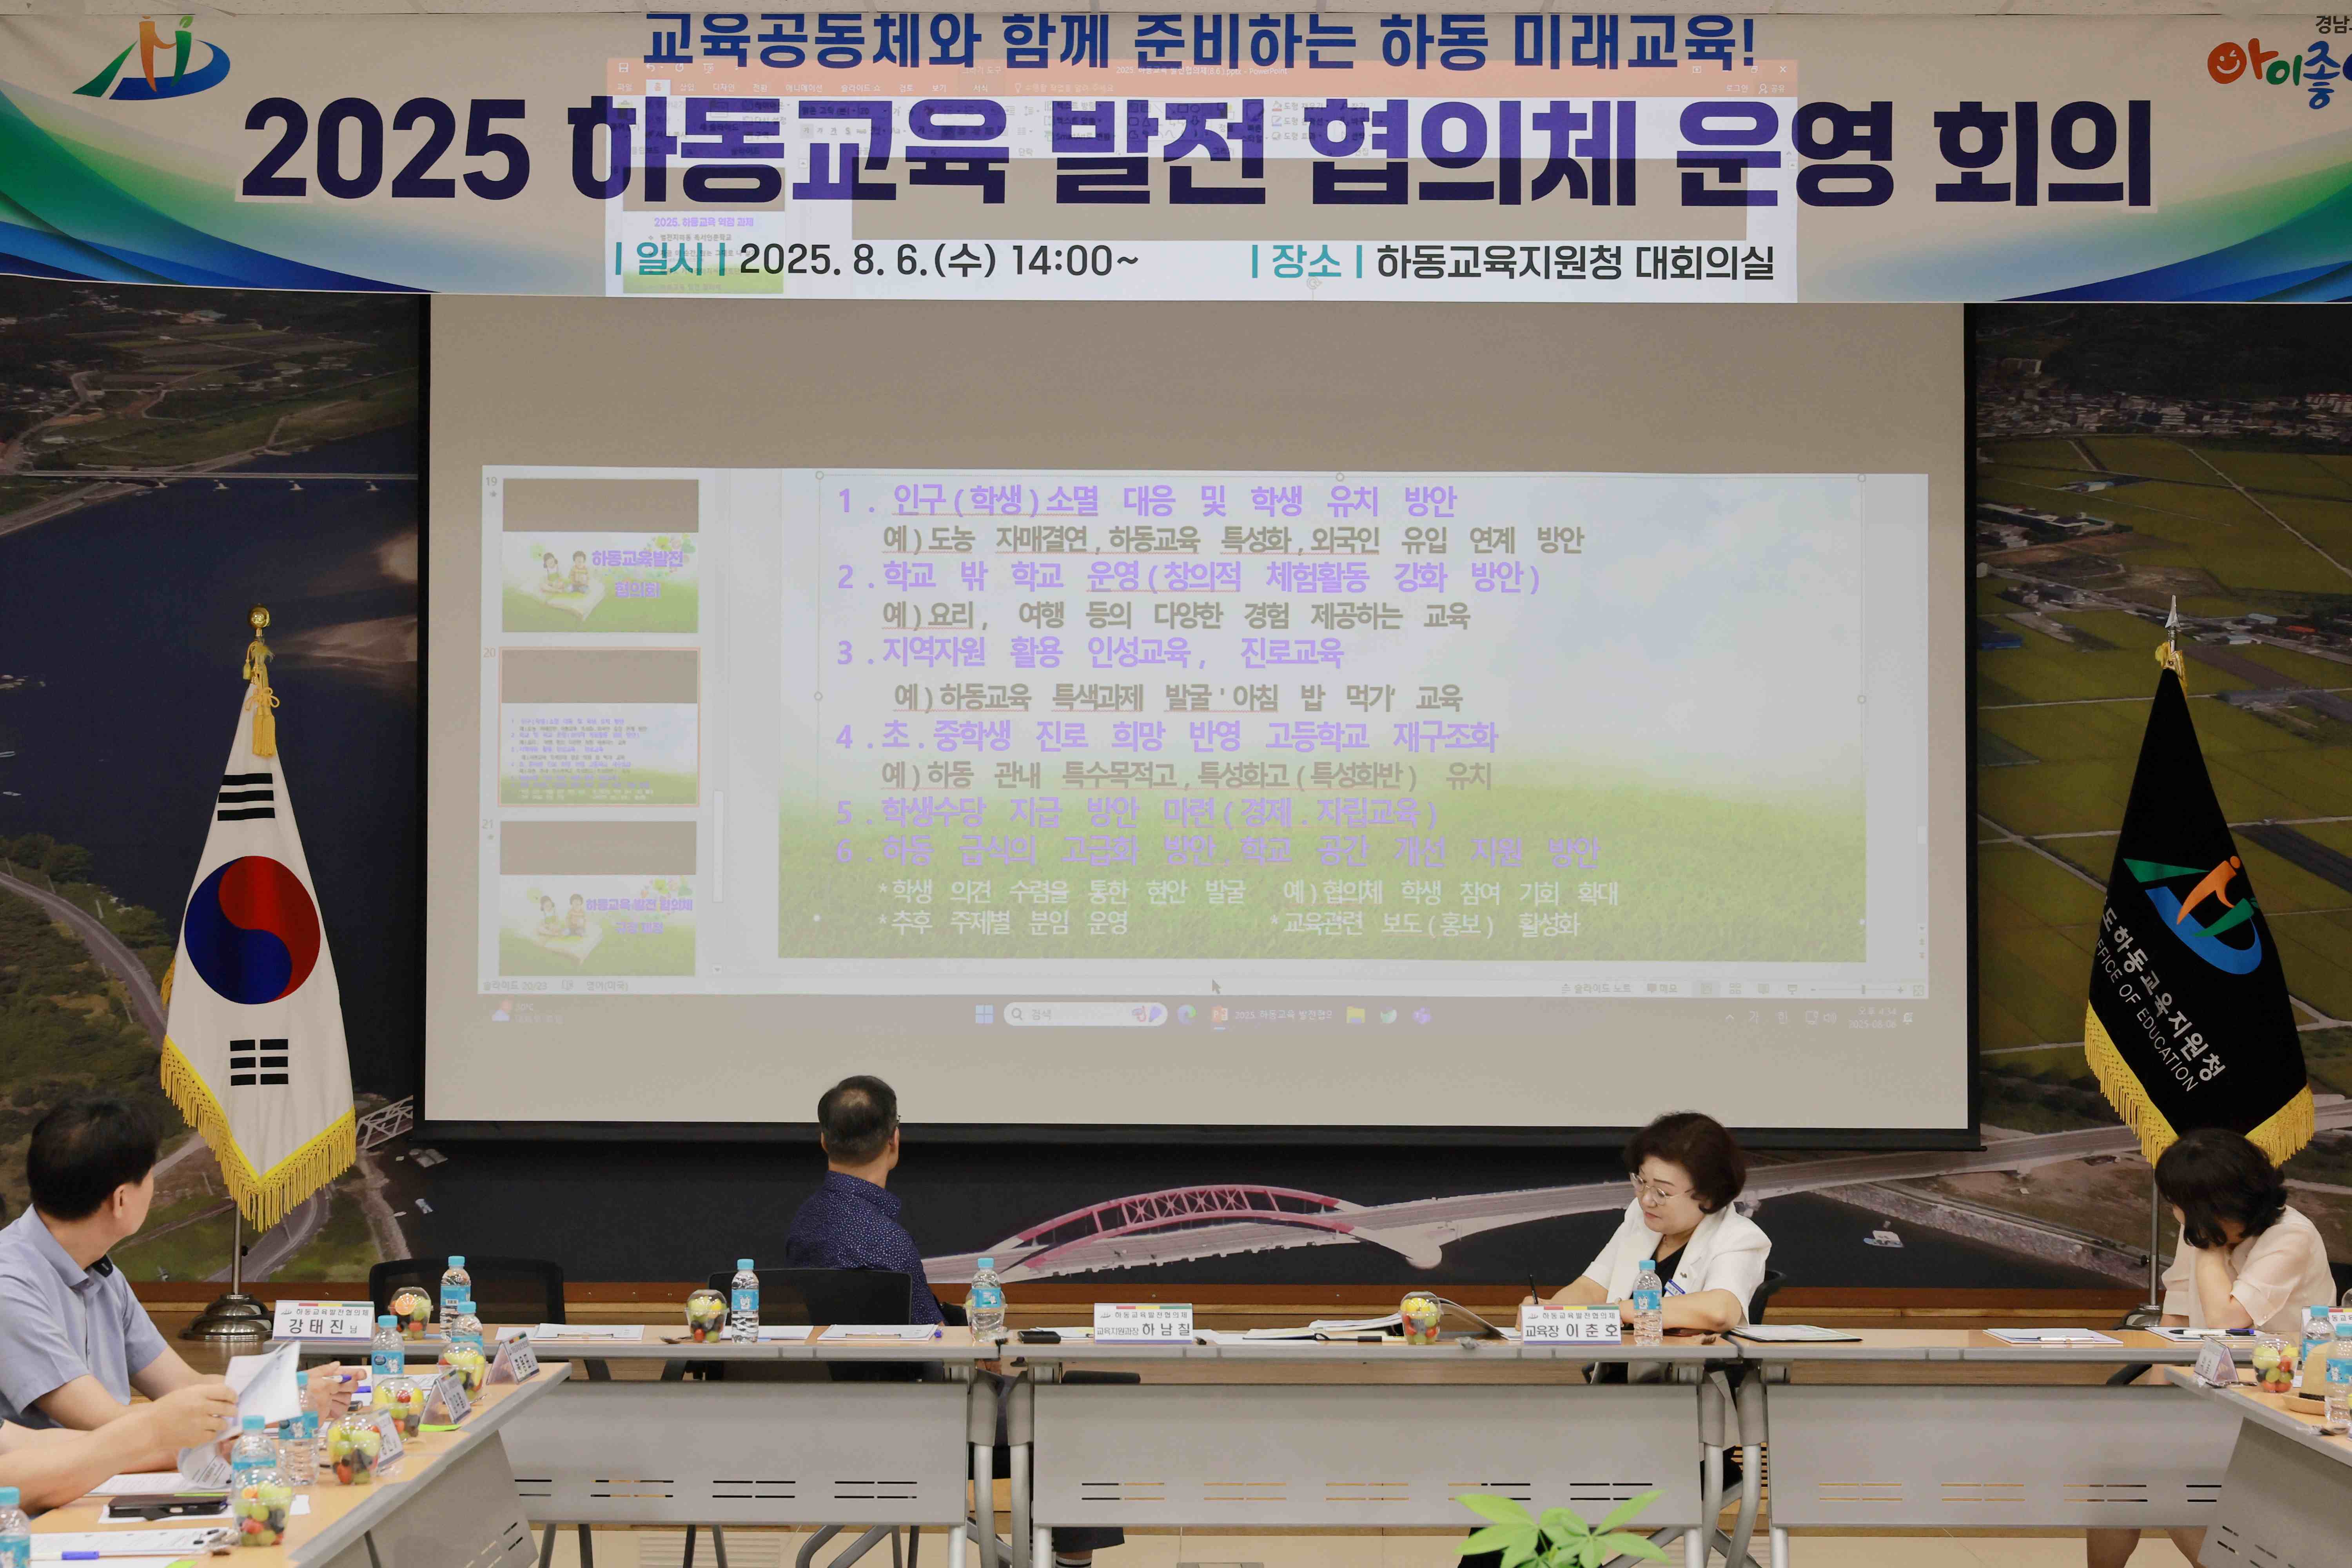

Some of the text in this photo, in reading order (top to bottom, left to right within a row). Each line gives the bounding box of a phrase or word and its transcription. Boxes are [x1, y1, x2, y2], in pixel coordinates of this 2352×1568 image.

[2315, 15, 2352, 34] 경남
[644, 13, 1755, 71] 교육공동체와 함께 준비하는 하동 미래교육!
[2207, 38, 2352, 109] 아이좋
[242, 96, 2151, 207] 2025 하동교육 발전 협의체 운영 회의
[654, 217, 680, 227] 2025.
[682, 217, 716, 227] 하동교육
[636, 241, 703, 276] 일시
[740, 242, 1139, 278] 2025. 8. 6.(수) 14:00~
[1272, 244, 1342, 279] 장소
[1377, 244, 1774, 281] 하동교육지원청 대회의실
[894, 483, 1098, 518] 인구(학생)소멸
[1124, 484, 1176, 517] 대응
[1201, 485, 1227, 517] 및
[1250, 485, 1303, 517] 학생
[1327, 485, 1379, 517] 유치
[1405, 485, 1457, 518] 방안
[1401, 526, 1447, 555] 유입
[1469, 526, 1516, 555] 연계
[1538, 526, 1585, 555] 방안
[960, 561, 988, 592] 밖
[1010, 561, 1064, 592] 학교
[1087, 561, 1241, 594] 운영(창의적
[1266, 561, 1370, 593] 체험활동
[1394, 562, 1448, 594] 강화
[1471, 561, 1540, 595] 방안)
[1019, 601, 1064, 630] 여행
[1085, 601, 1132, 630] 등의
[1153, 601, 1224, 630] 다양한
[1244, 602, 1290, 630] 경험
[1311, 602, 1404, 630] 제공하는
[1423, 602, 1471, 630] 교육
[1010, 635, 1063, 669] 활용
[1240, 637, 1345, 670] 진로교육
[1052, 683, 1143, 712] 특색과제
[1301, 684, 1326, 713] 밥
[1416, 684, 1464, 713] 교육
[1035, 720, 1089, 752] 진로
[1111, 720, 1166, 753] 희망
[1189, 720, 1241, 753] 반영
[1265, 720, 1370, 753] 고등학교
[1392, 720, 1499, 753] 재구조화
[993, 761, 1042, 790] 관내
[1446, 762, 1492, 791] 유치
[1009, 796, 1063, 829] 지급
[1087, 796, 1140, 829] 방안
[958, 834, 1036, 866] 급식의
[1062, 834, 1140, 867] 고급화
[1316, 835, 1371, 868] 공간
[1394, 836, 1446, 869] 개선
[1470, 837, 1522, 869] 지원
[1548, 837, 1601, 870] 방안
[950, 879, 991, 906] 의견
[1009, 880, 1070, 906] 수렴을
[1088, 879, 1130, 905] 통한
[1145, 879, 1188, 906] 현안
[1205, 879, 1247, 905] 발굴
[1400, 880, 1442, 906] 학생
[1459, 881, 1500, 906] 참여
[1519, 881, 1559, 906] 기회
[1577, 881, 1618, 906] 확대
[950, 909, 1011, 935] 주제별
[1028, 910, 1069, 935] 분임
[1087, 910, 1128, 935] 운영
[1518, 913, 1581, 938] 활성화
[2097, 935, 2198, 1092] FFICE OF EDUCATION
[289, 1319, 343, 1334] 강태진
[1142, 1323, 1190, 1336] 하남칠
[1525, 1323, 1619, 1338] 교육장 이춘호
